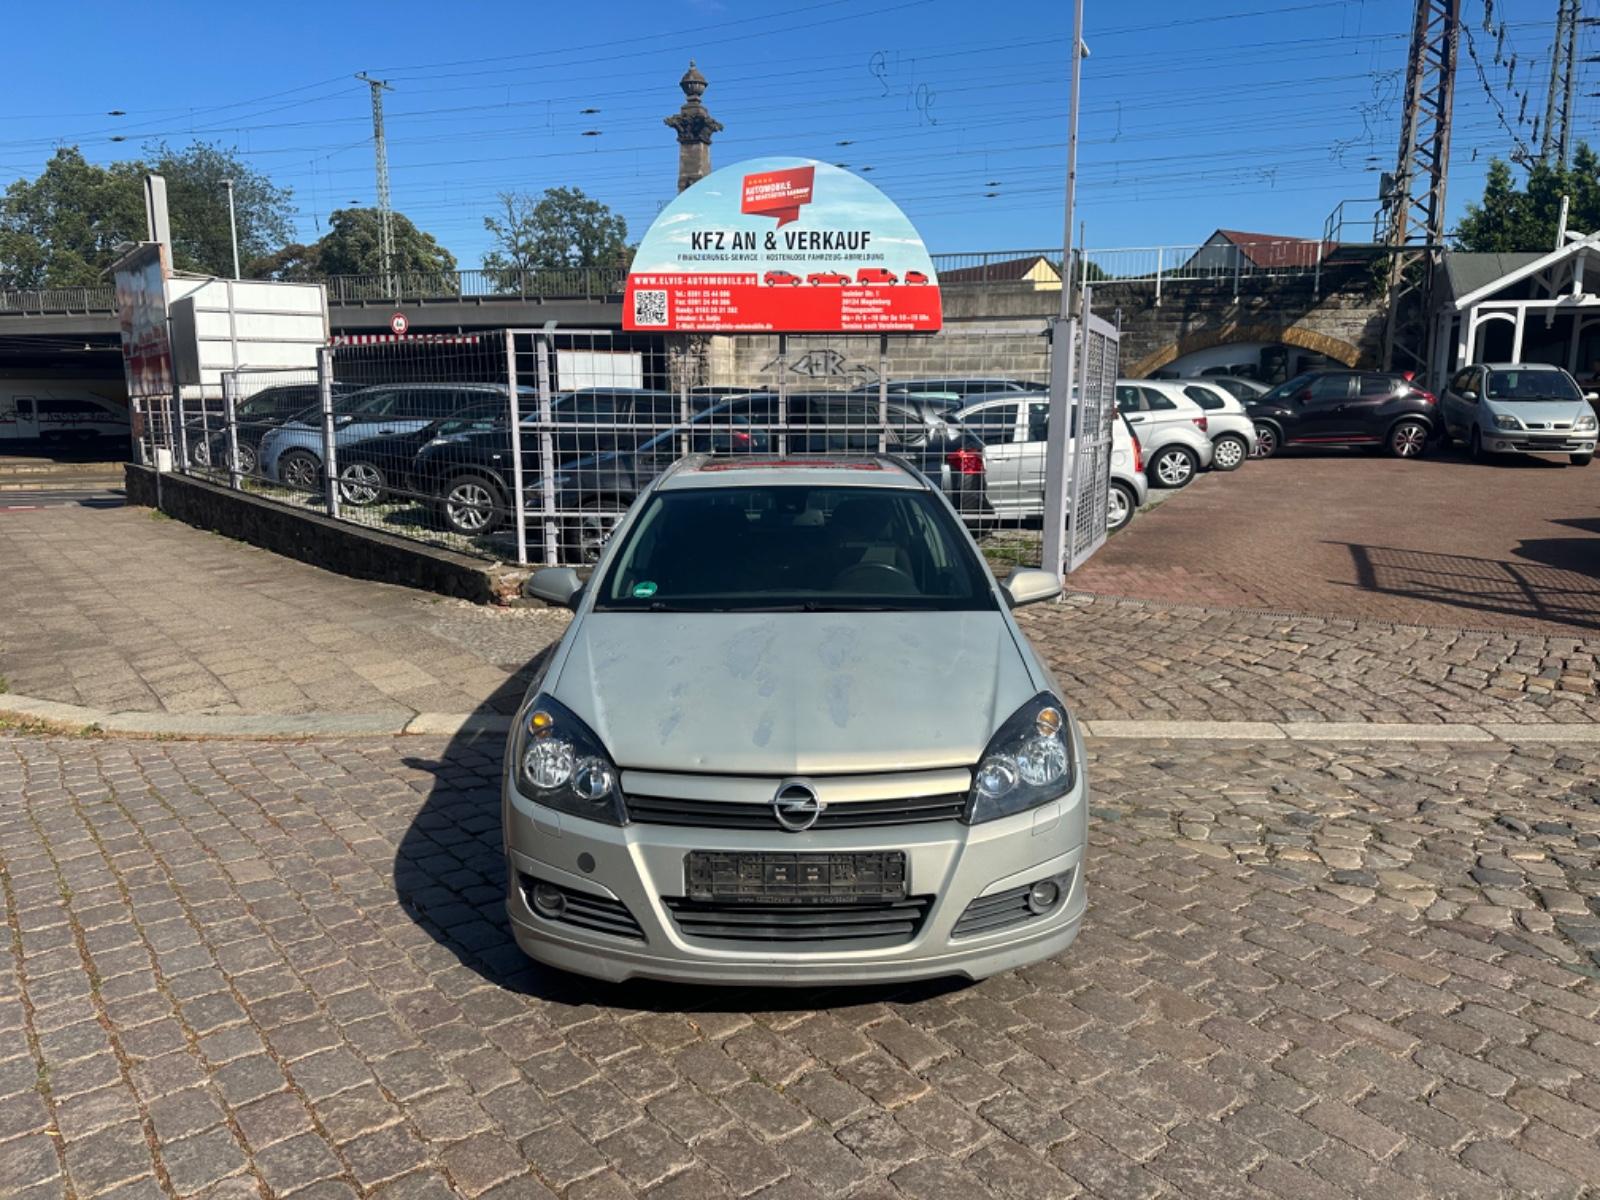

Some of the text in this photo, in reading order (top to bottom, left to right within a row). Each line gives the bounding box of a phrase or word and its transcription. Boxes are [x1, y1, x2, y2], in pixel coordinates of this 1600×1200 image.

[745, 180, 792, 195] AUTOMOBILE
[691, 231, 871, 250] KFZ AN & VERKAUF
[677, 253, 758, 261] FINANZIERUNGS-SERVICE
[766, 253, 806, 261] KOSTENLOSE
[634, 276, 756, 285] WWW.ELVIS-AUTOMOBILE.DE
